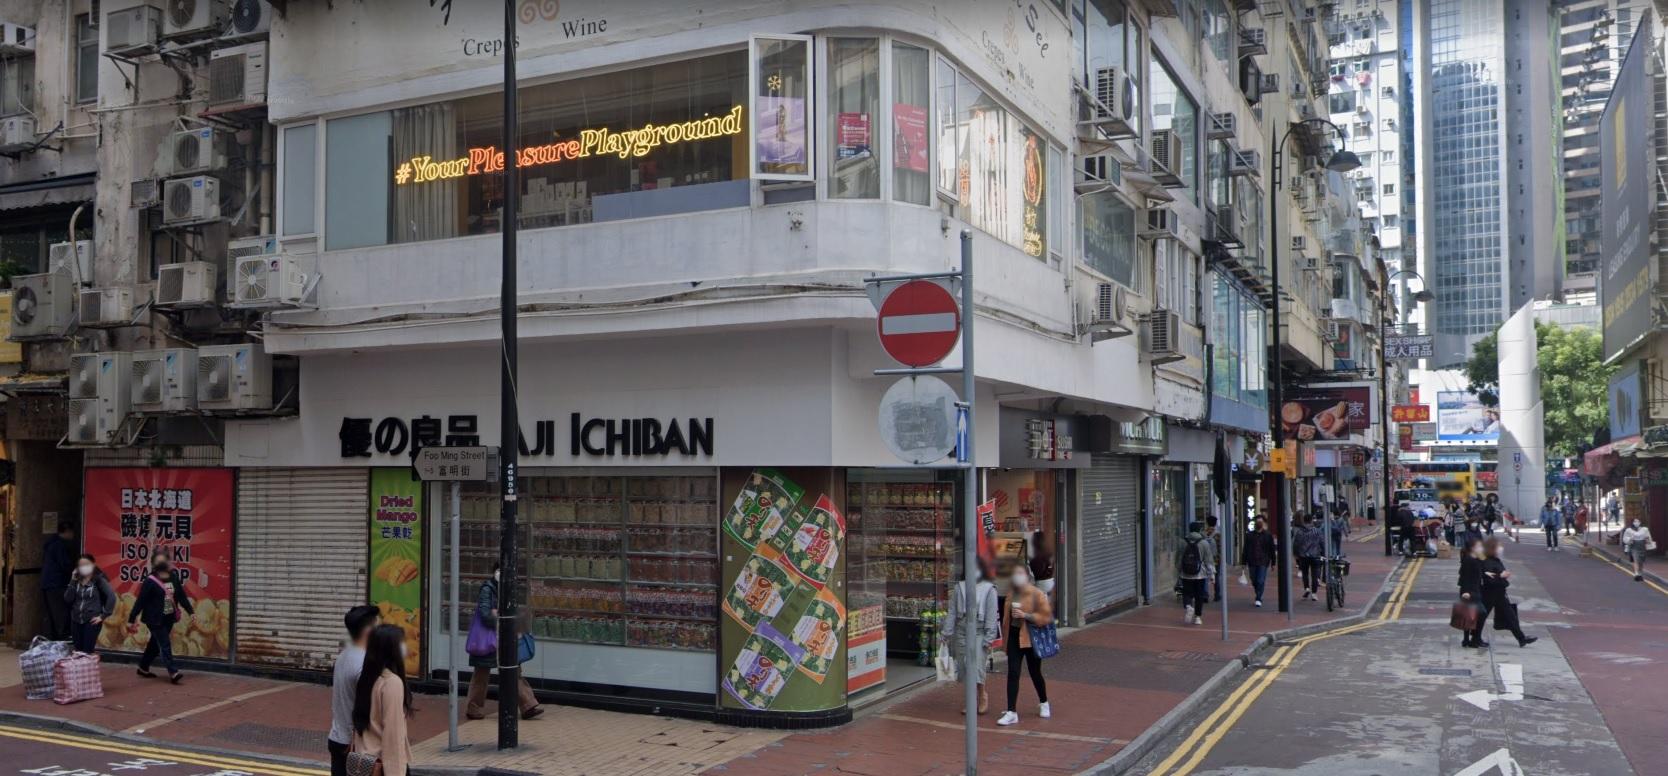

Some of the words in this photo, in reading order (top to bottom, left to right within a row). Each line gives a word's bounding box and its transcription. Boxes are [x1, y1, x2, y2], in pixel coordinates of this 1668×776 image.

[562, 18, 608, 39] Wine
[463, 34, 520, 57] Creps
[339, 415, 480, 458] 優の良品
[571, 412, 713, 456] ICHIBAN
[424, 450, 440, 460] Foo
[441, 450, 458, 461] Ming
[460, 450, 485, 460] Street
[438, 464, 470, 477] 富明街
[120, 487, 193, 511] 日本北海道
[380, 495, 414, 508] Dried
[376, 509, 418, 524] Mango
[381, 526, 413, 539] 芒果乾
[120, 543, 191, 563] ISOKI
